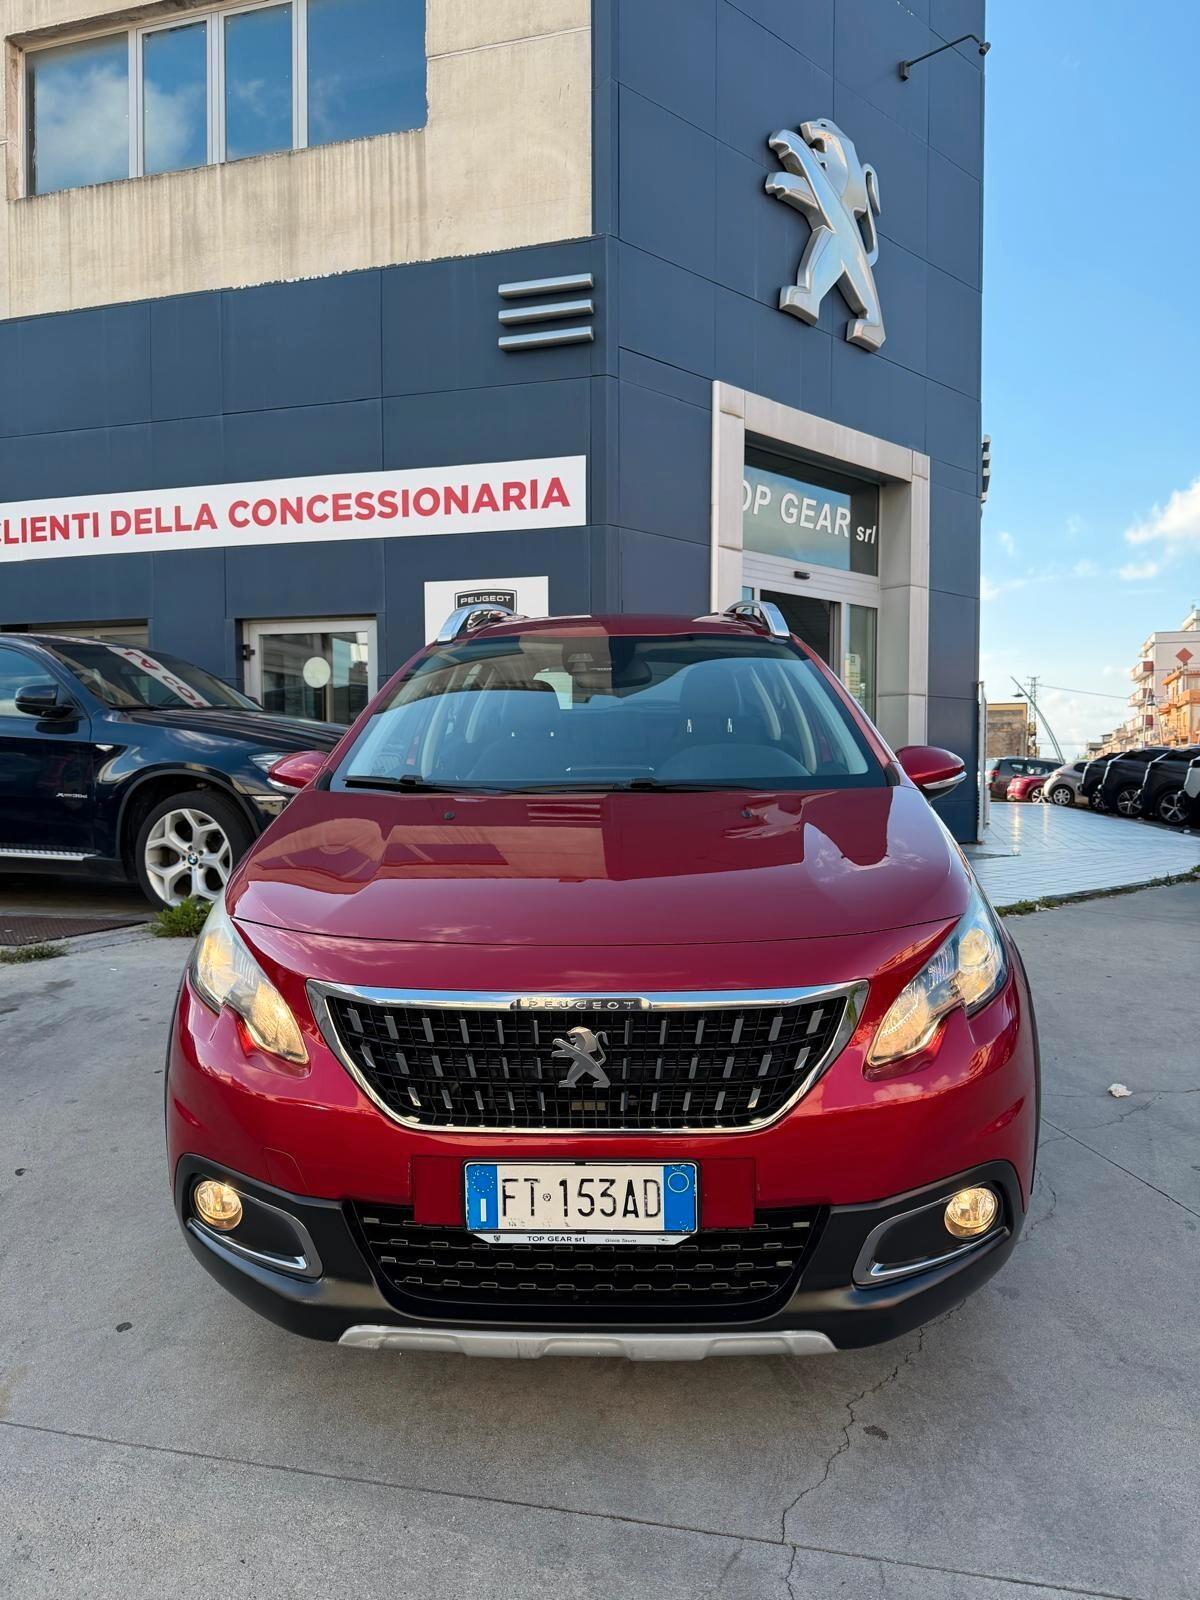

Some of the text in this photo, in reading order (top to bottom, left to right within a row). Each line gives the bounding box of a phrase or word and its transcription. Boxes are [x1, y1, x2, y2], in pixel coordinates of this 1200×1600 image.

[0, 477, 570, 544] LIENTI DELLA CONCESSIONARIA
[780, 493, 851, 538] GEAR
[856, 525, 876, 544] srl
[460, 595, 512, 604] PEUGEOT
[528, 1000, 635, 1010] PEUGEOT
[502, 1178, 540, 1217] FT
[559, 1178, 662, 1218] 153AD
